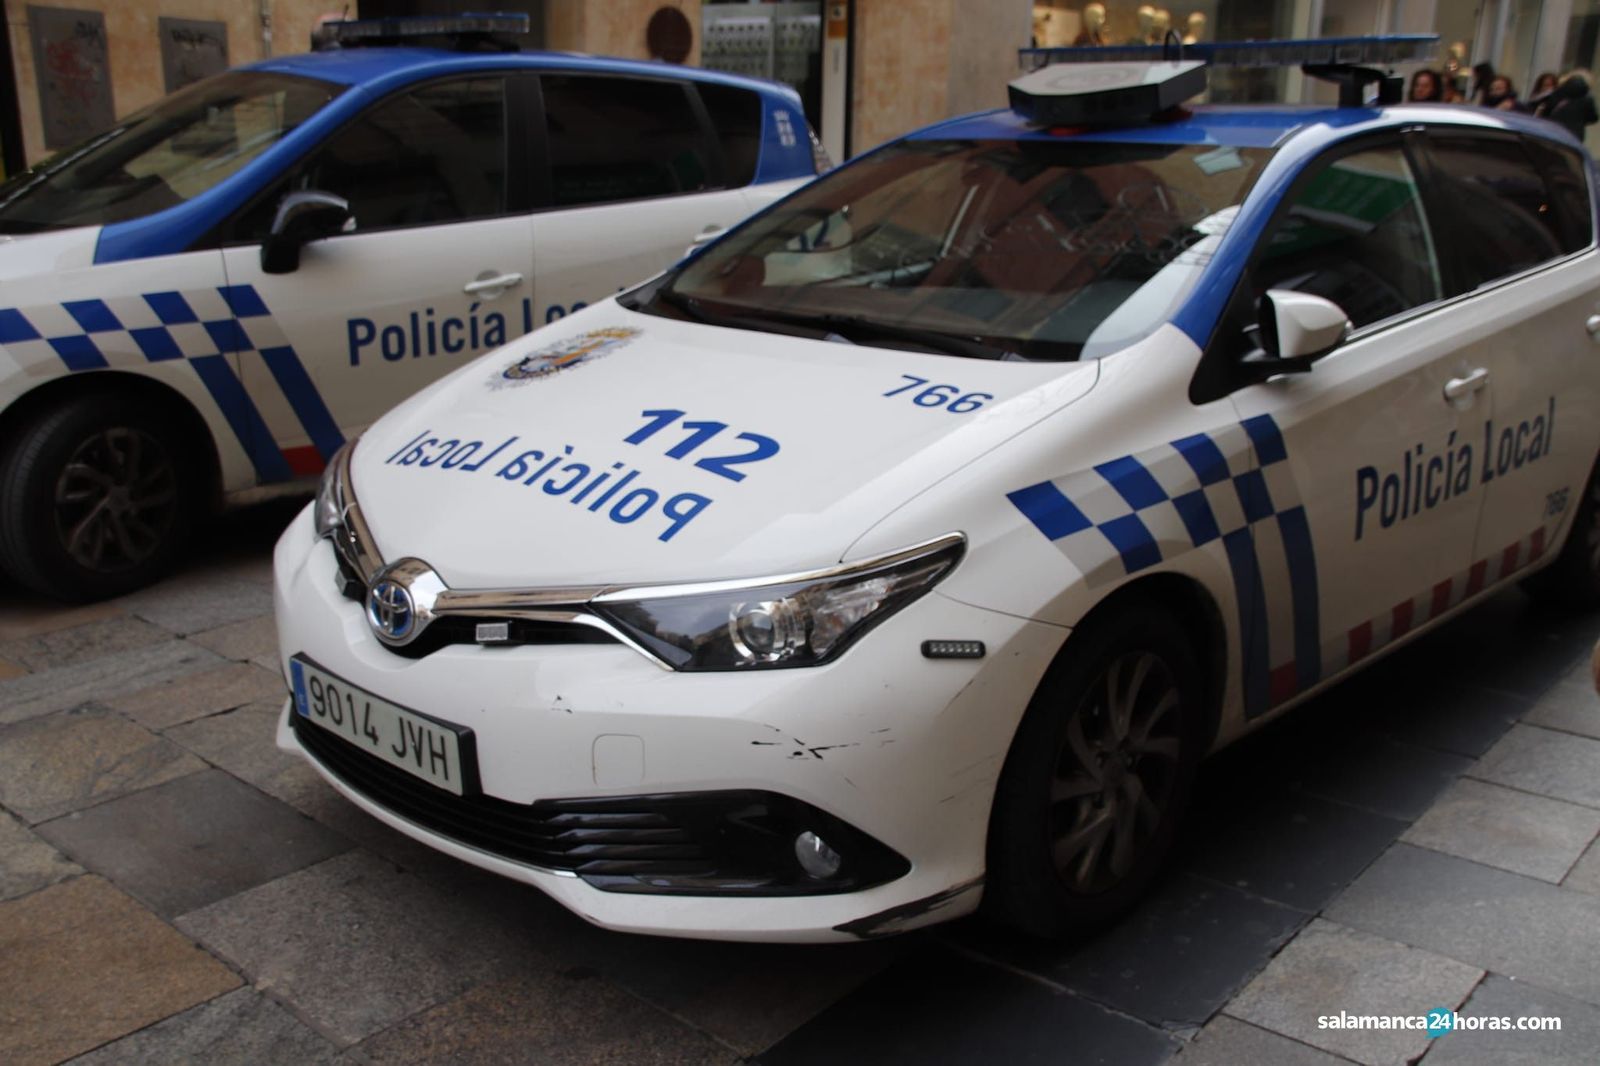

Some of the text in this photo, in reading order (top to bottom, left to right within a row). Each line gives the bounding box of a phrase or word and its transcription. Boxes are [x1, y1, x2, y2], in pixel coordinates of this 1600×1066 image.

[347, 302, 506, 366] Policía
[882, 374, 994, 413] 766
[623, 409, 780, 482] 112
[1354, 396, 1556, 542] Policía Local
[309, 675, 449, 781] 9014 JVH
